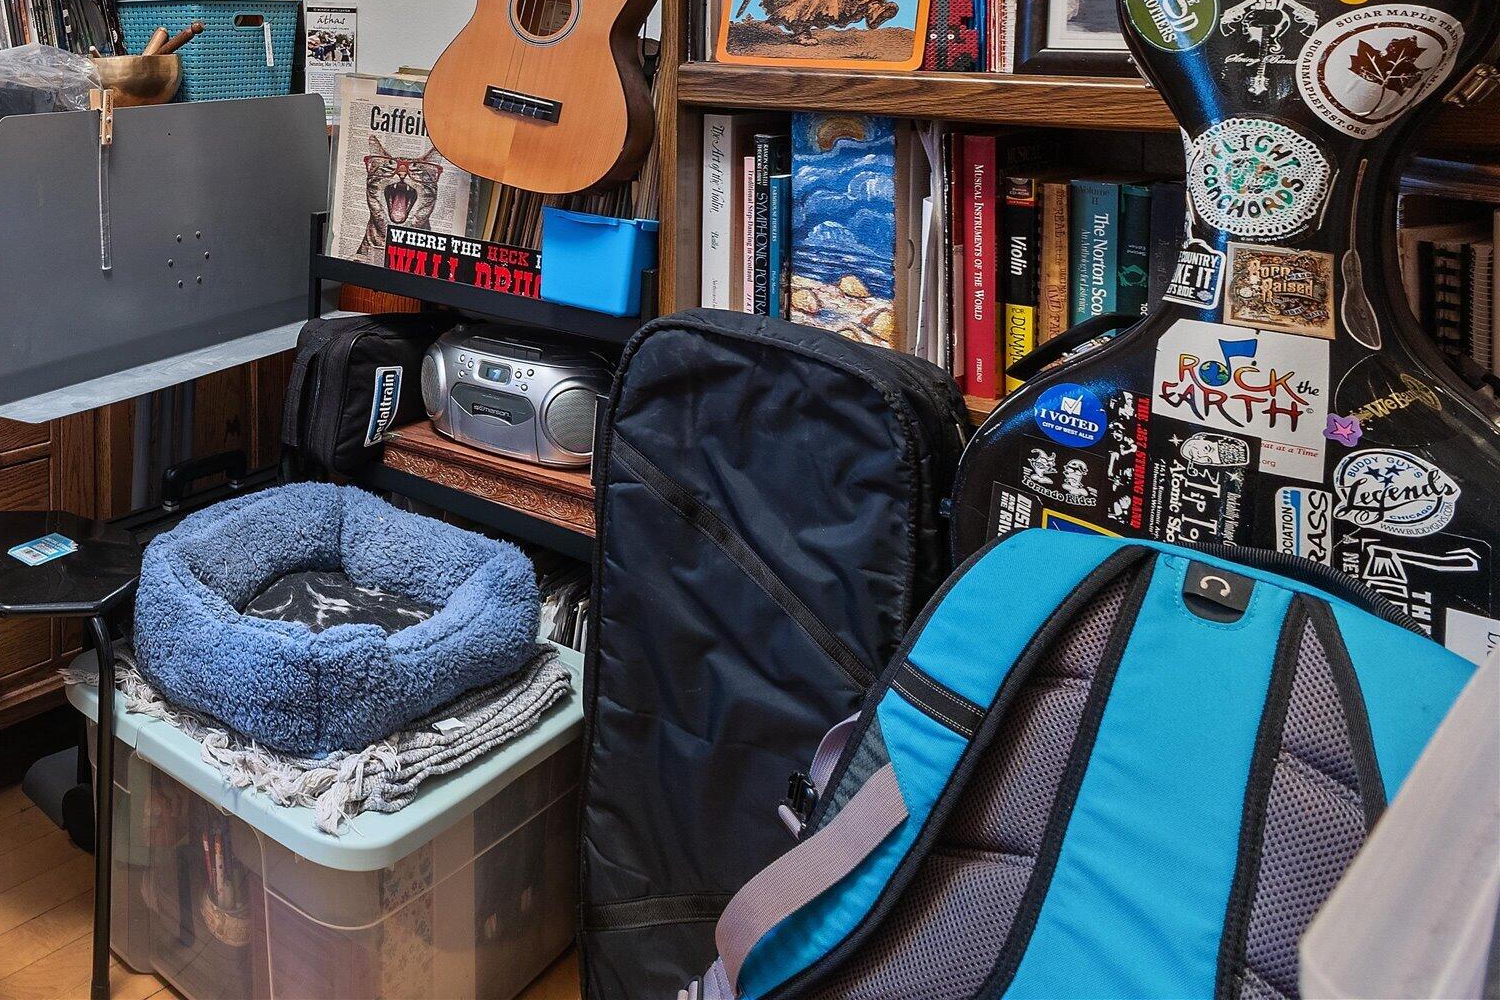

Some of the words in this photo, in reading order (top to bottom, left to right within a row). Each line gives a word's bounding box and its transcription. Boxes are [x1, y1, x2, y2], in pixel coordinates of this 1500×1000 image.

[1336, 10, 1382, 28] SUGAR
[1386, 9, 1437, 23] MAPLE
[1302, 39, 1367, 136] SUGARMAPLEFEST.ORG
[711, 125, 725, 143] The
[974, 164, 985, 202] MUSICAL
[756, 192, 769, 266] SYMPHONIC
[973, 202, 984, 257] INSTRUMENTS
[1093, 213, 1109, 237] The
[390, 229, 447, 251] WHERE
[451, 237, 482, 258] THE
[487, 246, 530, 267] HECK
[1010, 235, 1027, 277] Violin
[1092, 239, 1108, 284] Norton
[974, 271, 982, 287] THE
[1196, 268, 1215, 291] IT.
[1248, 260, 1290, 284] Born
[974, 288, 985, 321] WORLD
[1261, 280, 1314, 302] Raised
[1179, 352, 1310, 405] ROCK
[1296, 380, 1319, 397] the
[373, 373, 395, 442] pedaltrain
[1041, 408, 1047, 418] I
[1049, 411, 1099, 433] VOTED
[1137, 398, 1150, 422] THE
[1159, 381, 1303, 432] EARTH
[1063, 426, 1077, 436] WEST
[1078, 432, 1094, 440] ALLIS
[1297, 447, 1319, 458] Time
[1349, 456, 1378, 478] BUDDY
[1386, 456, 1423, 479] GUY'S
[1133, 451, 1147, 495] STRING
[1168, 459, 1186, 514] Atomic
[1021, 476, 1064, 501] Tornado
[1066, 494, 1097, 507] Rider
[1182, 478, 1221, 512] Tip
[1336, 468, 1458, 524] Legends
[1130, 497, 1143, 529] BAND
[1165, 515, 1182, 542] Sho
[1389, 505, 1433, 521] CHICAGO
